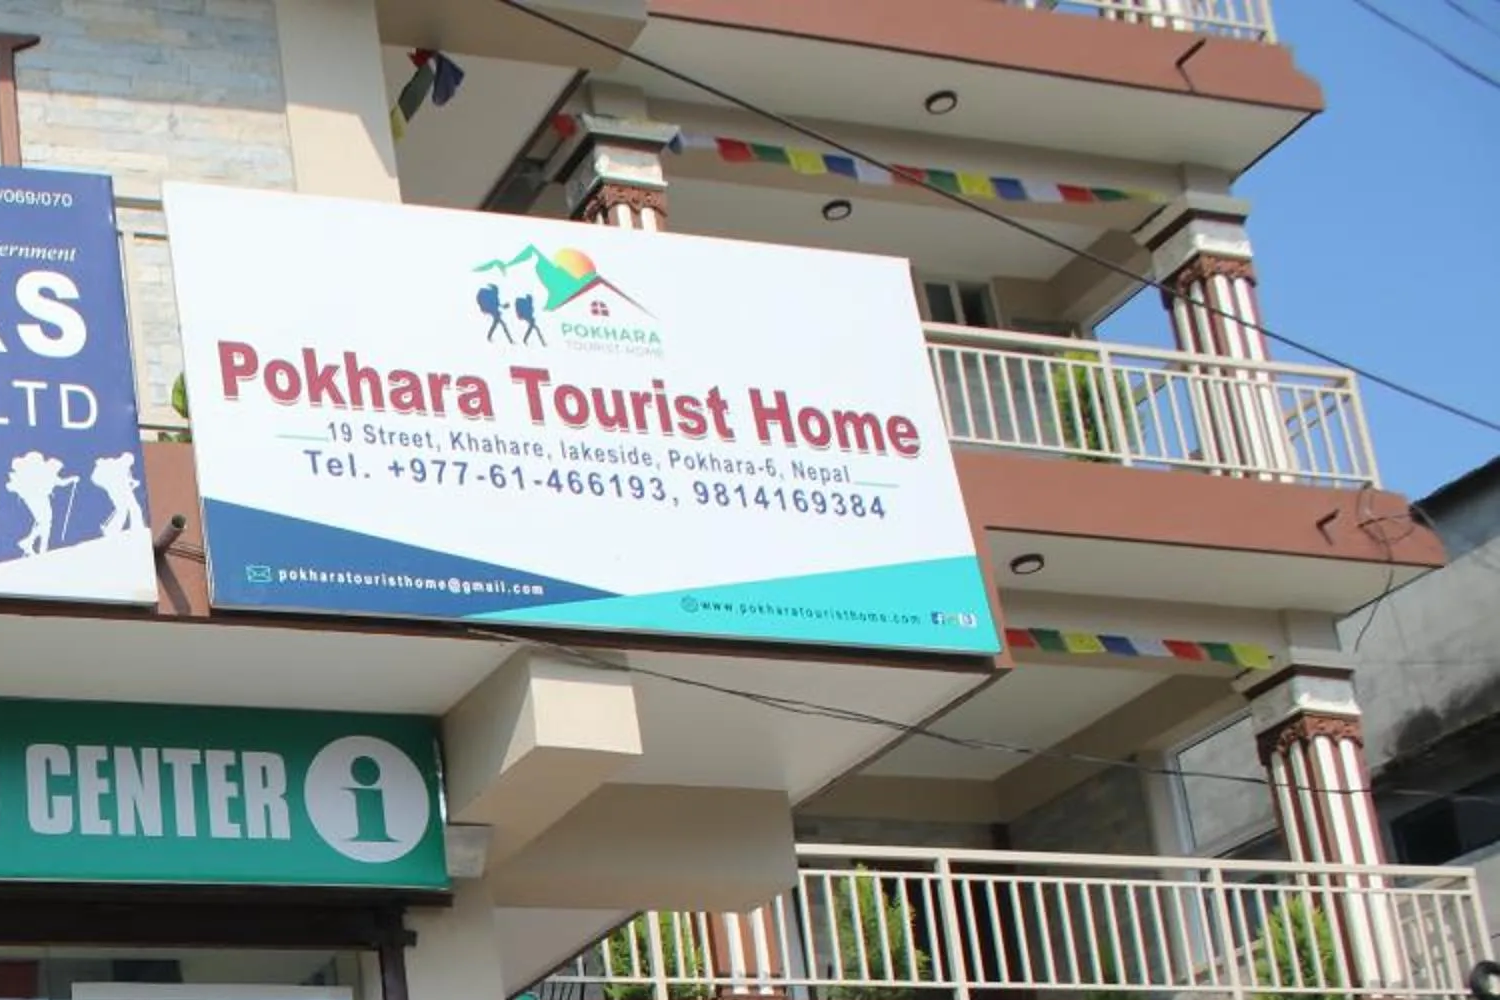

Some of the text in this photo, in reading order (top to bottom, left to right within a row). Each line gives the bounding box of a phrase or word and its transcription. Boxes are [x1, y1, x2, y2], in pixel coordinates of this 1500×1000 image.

[561, 322, 661, 344] POKHARA
[217, 339, 921, 458] Pokhara Tourist Home
[303, 449, 886, 519] Tel. +977-61-466193, 9814169384
[327, 421, 851, 485] 19 Street, Khahare, lakeside, Pokhara-6, Nepal
[278, 567, 545, 595] pokharatouristhome@gmail.com
[25, 743, 292, 841] CENTER
